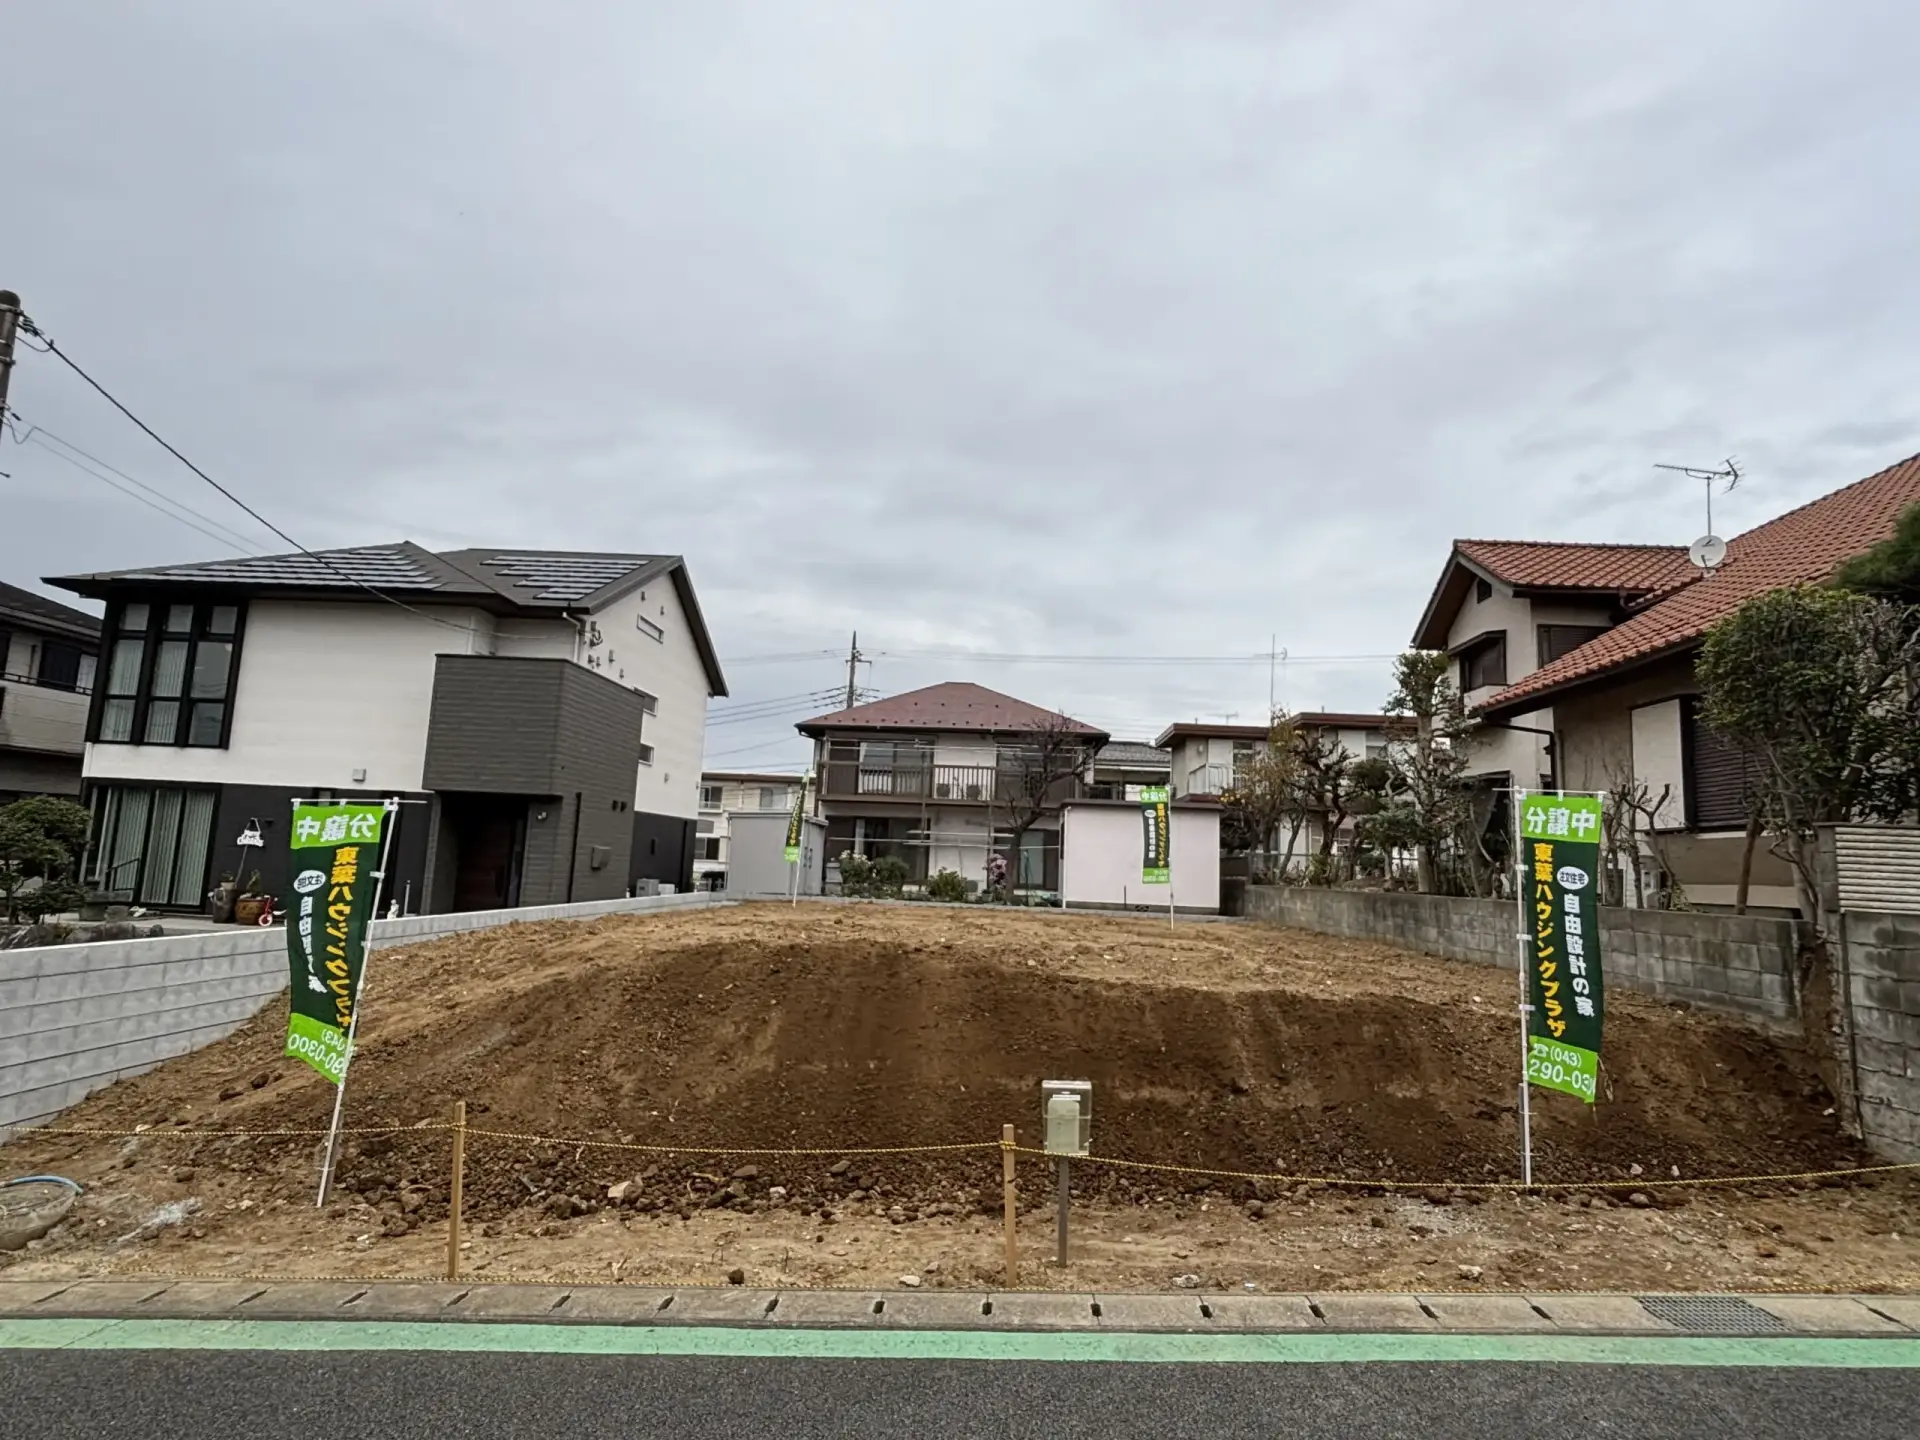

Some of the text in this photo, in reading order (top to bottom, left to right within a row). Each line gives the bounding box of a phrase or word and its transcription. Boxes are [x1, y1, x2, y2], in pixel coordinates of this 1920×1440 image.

[1526, 807, 1596, 837] 分譲中
[1533, 842, 1566, 1038] 東葉ハウジングプラザ
[1564, 893, 1595, 1018] 自由設計の家
[1550, 1045, 1582, 1068] (043)
